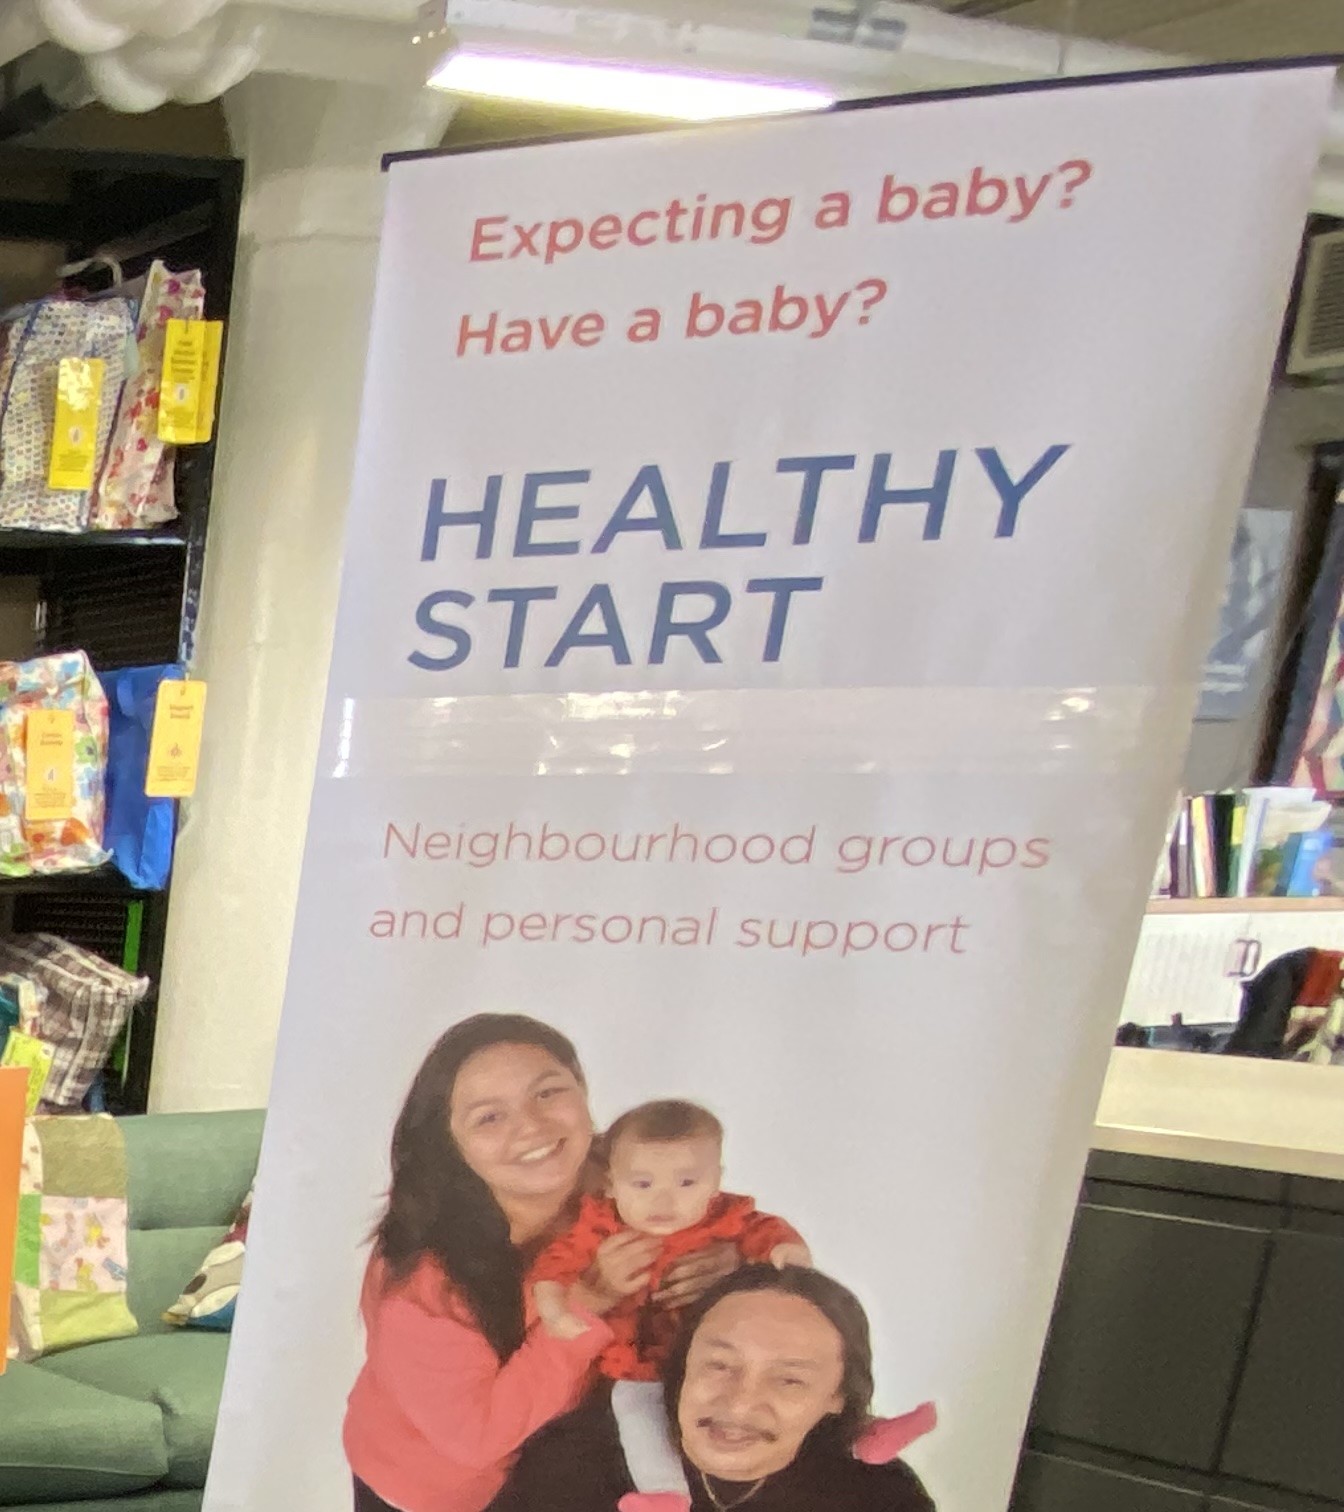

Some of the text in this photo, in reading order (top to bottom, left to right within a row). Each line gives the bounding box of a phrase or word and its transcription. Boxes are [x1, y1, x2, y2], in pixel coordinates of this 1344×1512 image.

[468, 158, 1095, 266] Expecting a baby?
[455, 276, 889, 358] Have a baby?
[420, 442, 1072, 563] HEALTHY
[406, 575, 825, 673] START
[382, 820, 1055, 878] Neighbourhood groups
[367, 902, 968, 958] and personal support
